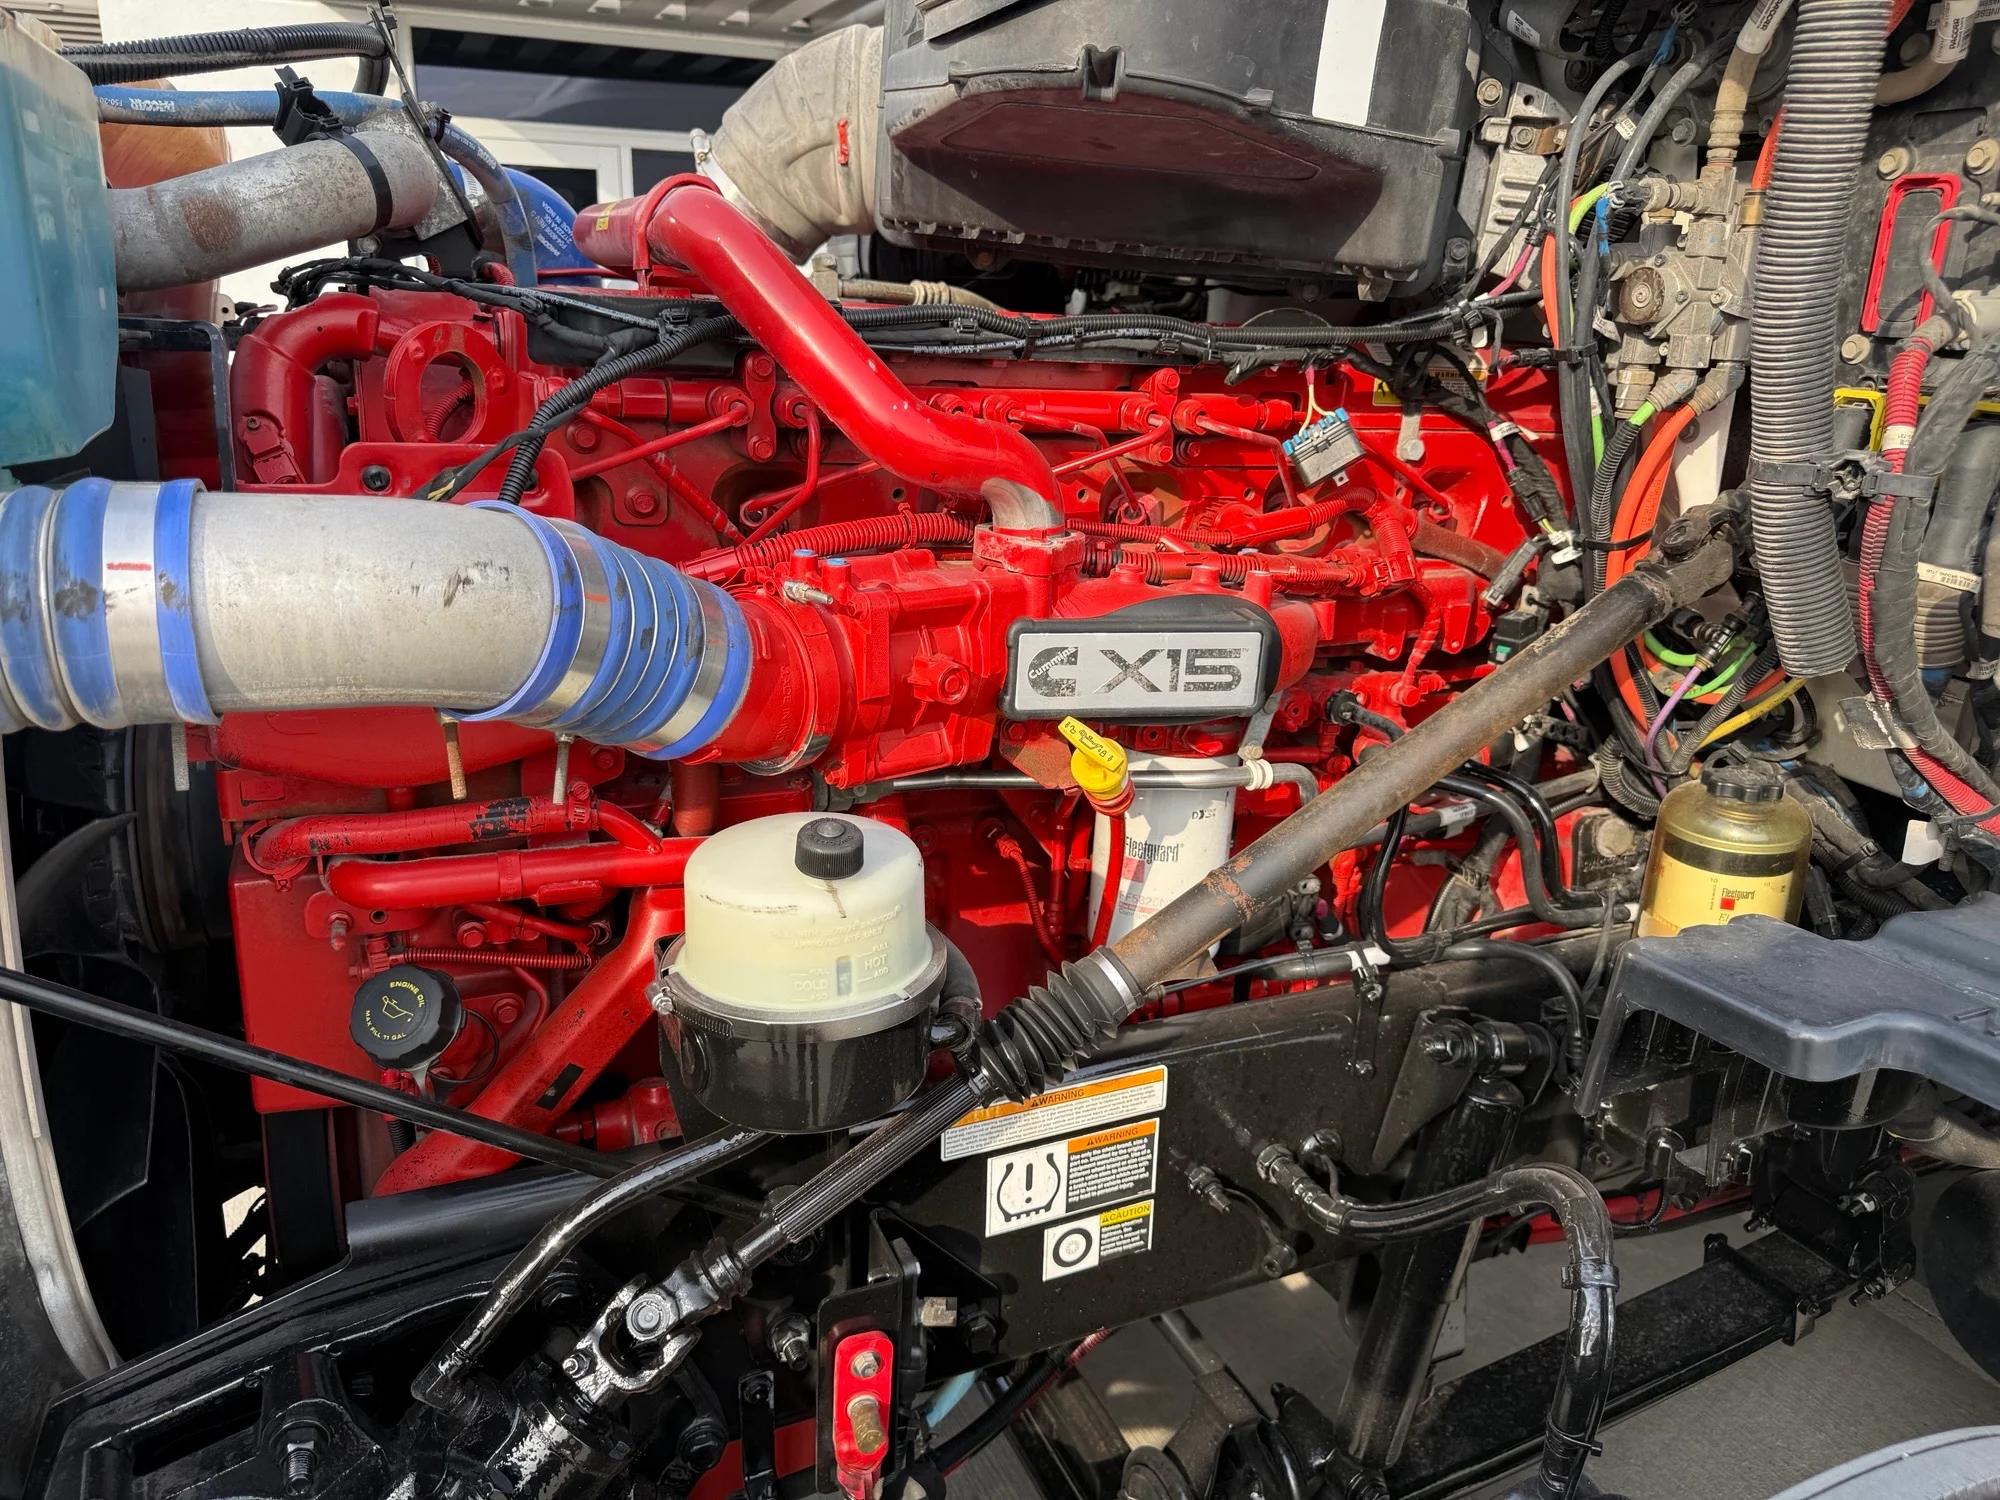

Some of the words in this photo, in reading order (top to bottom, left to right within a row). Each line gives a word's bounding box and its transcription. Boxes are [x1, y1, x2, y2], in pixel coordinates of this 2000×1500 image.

[1949, 18, 1961, 50] PACCAR
[1434, 370, 1464, 380] WARNIN
[1028, 646, 1076, 680] Cummins
[1093, 648, 1242, 693] X15
[1722, 888, 1756, 901] Fleetguard
[864, 925, 884, 938] ONLY
[873, 942, 890, 953] FULL
[864, 954, 887, 970] HOT
[874, 967, 889, 978] ADD
[794, 980, 829, 991] COLD
[390, 981, 420, 994] ENGINE
[417, 994, 425, 1008] OIL
[365, 1010, 374, 1027] MAX
[369, 1027, 381, 1038] FILL
[391, 1032, 407, 1041] GAL
[1038, 1089, 1085, 1105] WARNING
[1094, 1128, 1138, 1144] WARNING
[1110, 1205, 1150, 1220] CAUTION
